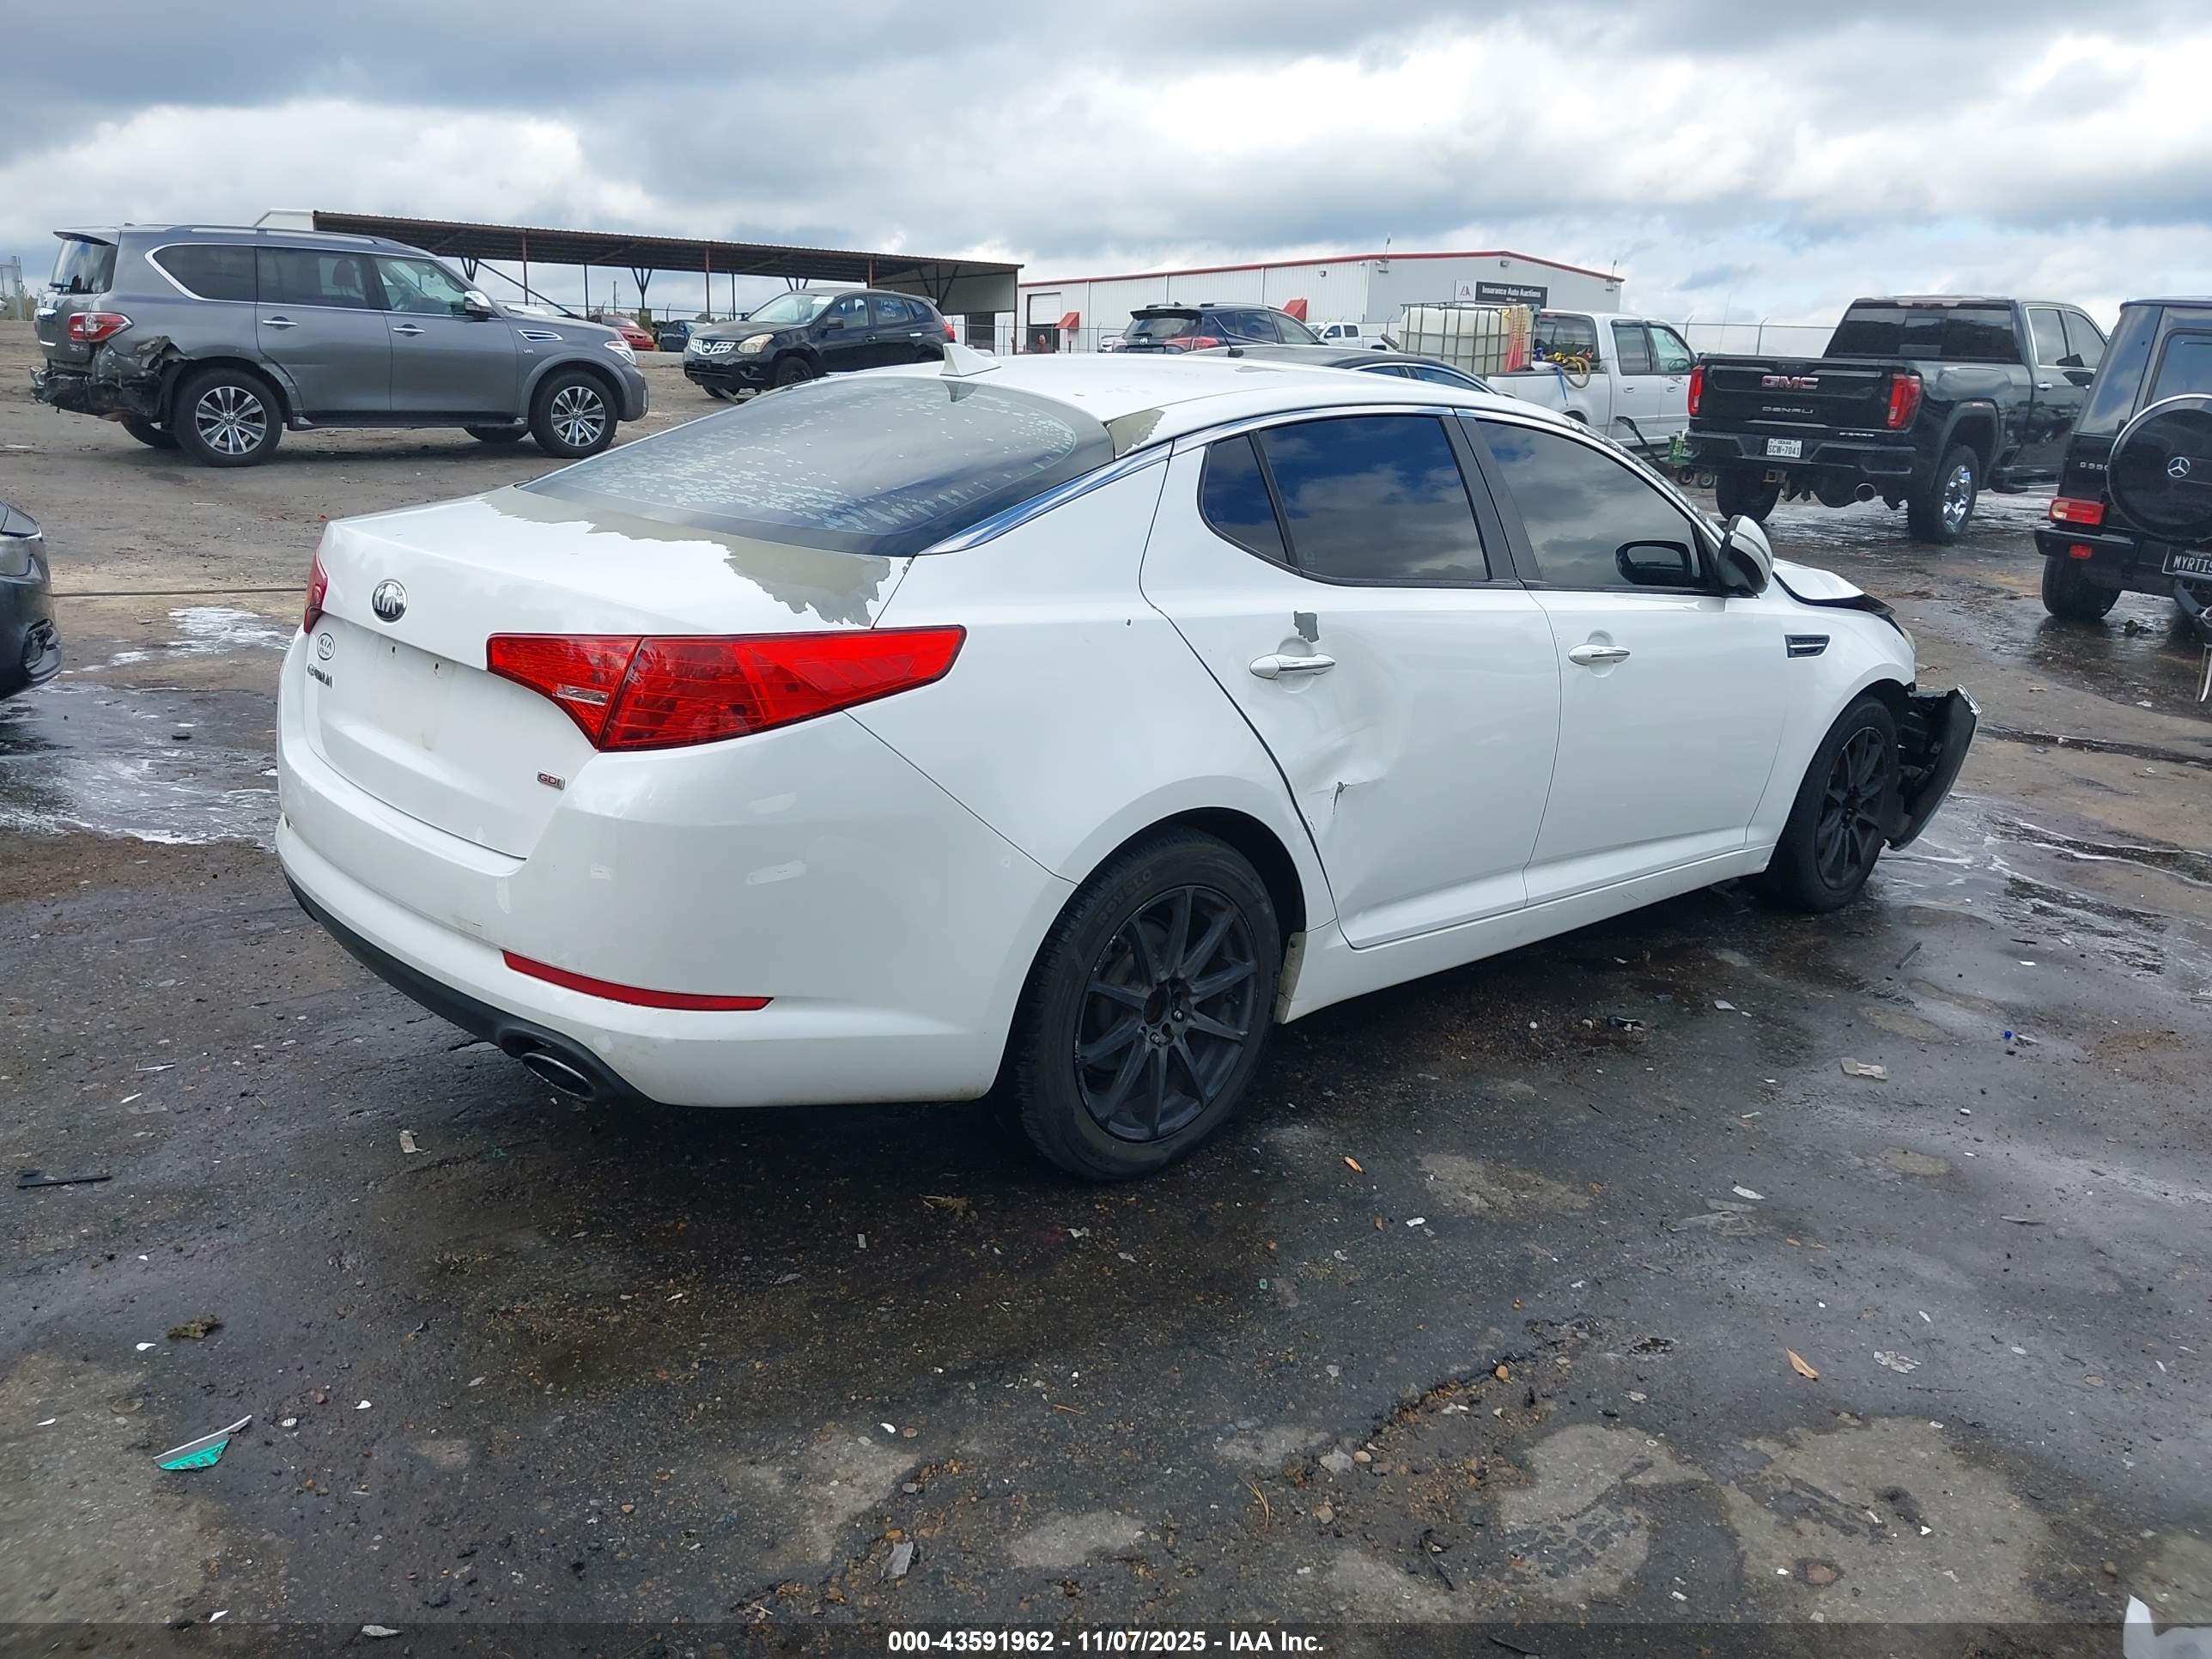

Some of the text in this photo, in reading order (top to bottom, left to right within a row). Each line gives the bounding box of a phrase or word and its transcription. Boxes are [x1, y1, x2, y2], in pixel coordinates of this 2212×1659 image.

[1481, 285, 1541, 298] Insurance Auto Auctions
[1761, 375, 1820, 390] GMC
[1761, 405, 1814, 414] DENALI
[319, 637, 332, 651] KIA
[538, 773, 562, 787] GDI
